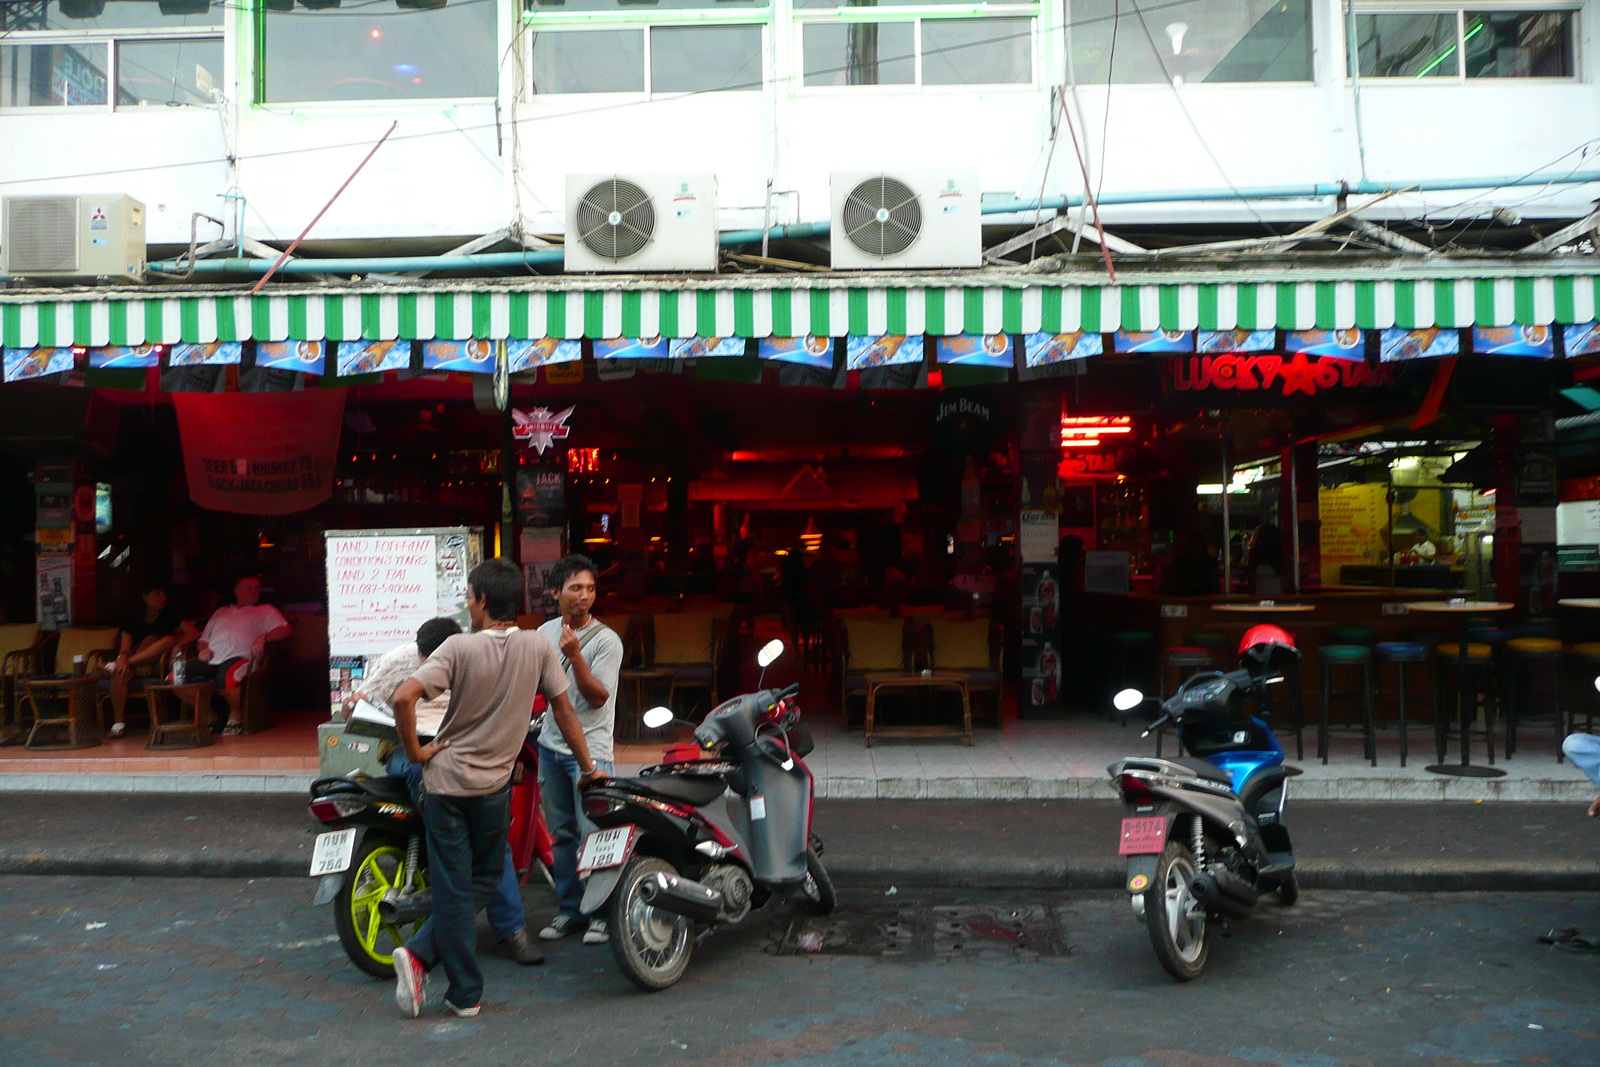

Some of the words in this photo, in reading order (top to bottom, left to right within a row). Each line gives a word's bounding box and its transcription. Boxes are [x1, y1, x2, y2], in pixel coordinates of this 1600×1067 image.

[1174, 354, 1283, 391] LUCKY
[935, 402, 958, 422] JIM
[959, 397, 990, 421] BEAM
[536, 472, 561, 486] JACK
[336, 541, 369, 554] LAND
[395, 555, 428, 566] YEARS
[337, 570, 365, 581] LAND
[371, 569, 380, 580] 2
